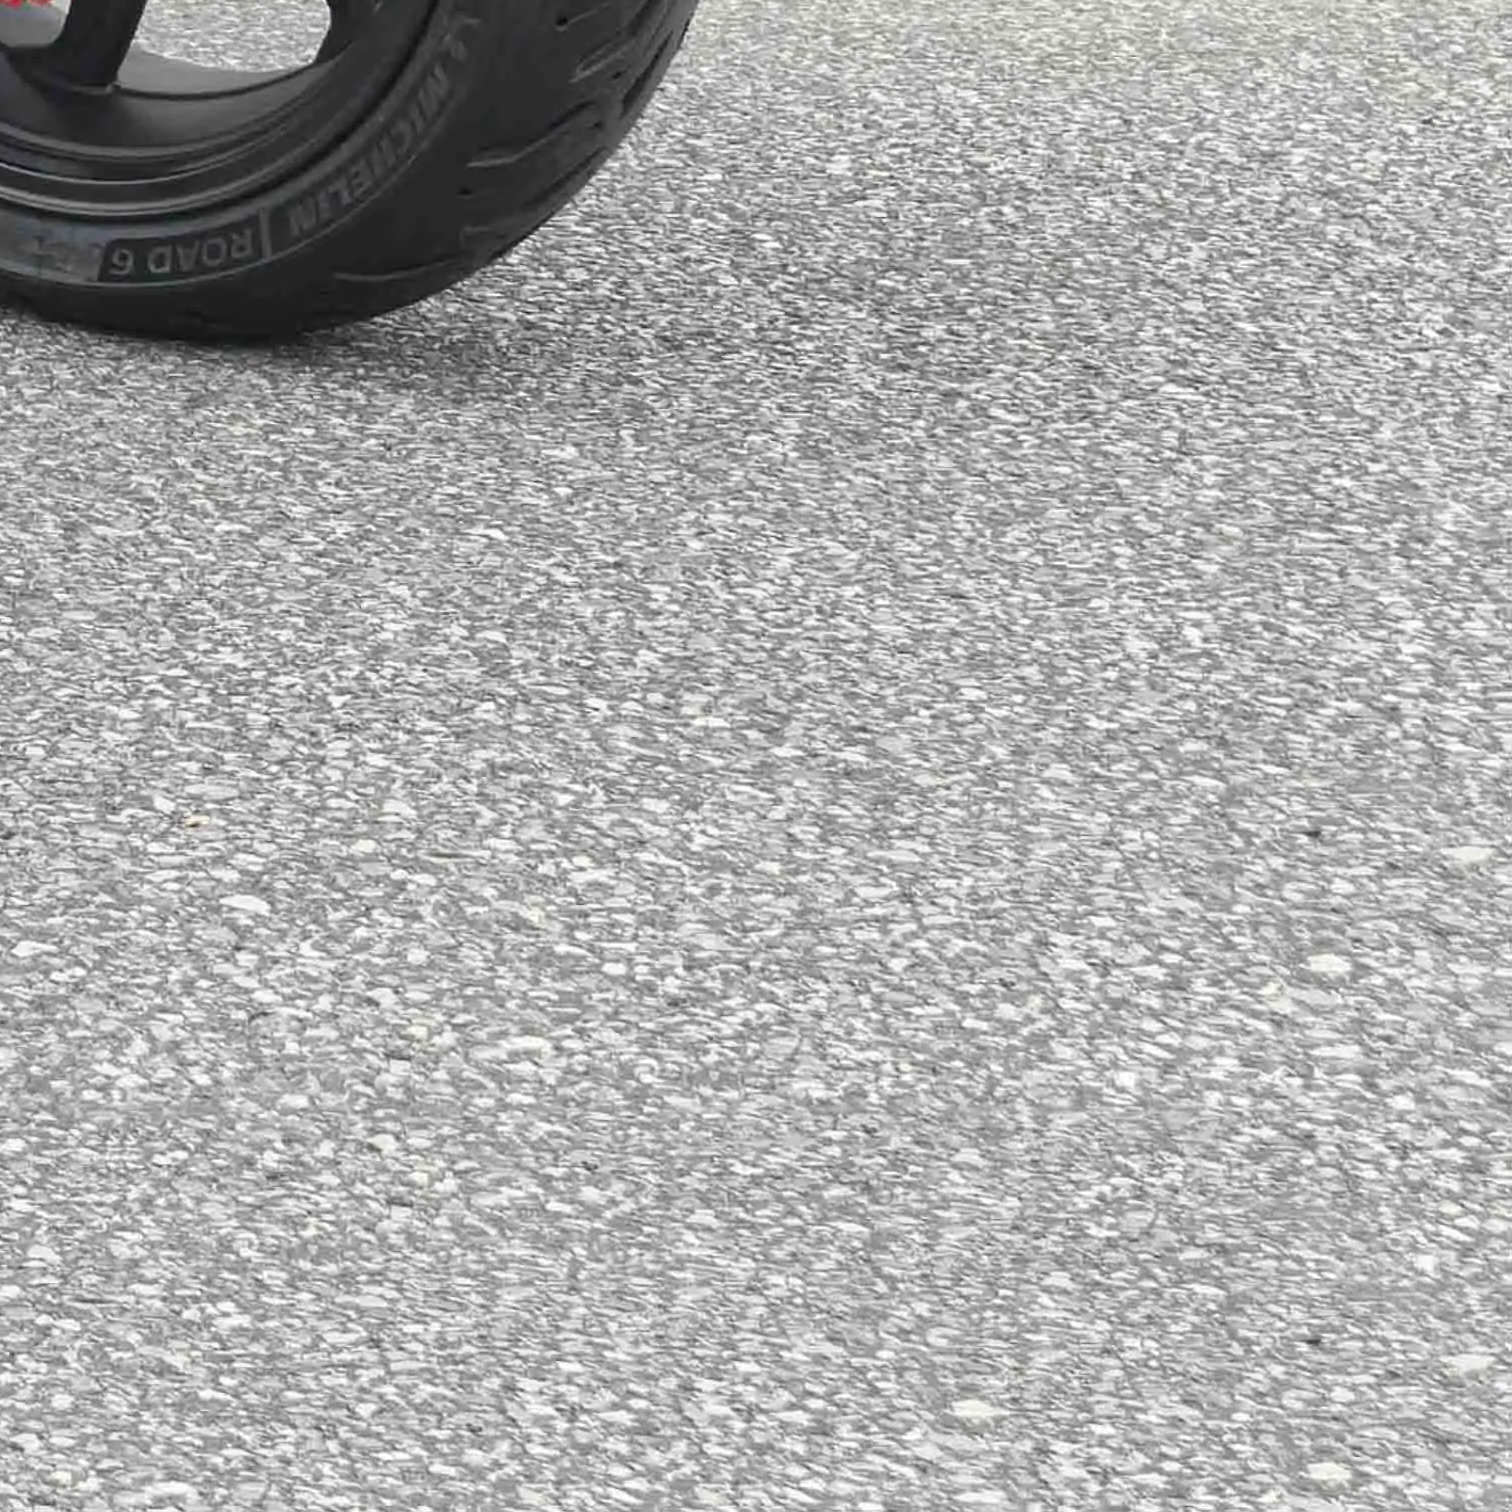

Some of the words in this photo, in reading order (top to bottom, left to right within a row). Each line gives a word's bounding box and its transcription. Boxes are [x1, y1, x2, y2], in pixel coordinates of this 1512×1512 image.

[287, 65, 452, 238] MICHELIN
[110, 247, 134, 276] 6
[148, 229, 255, 275] ROAD
